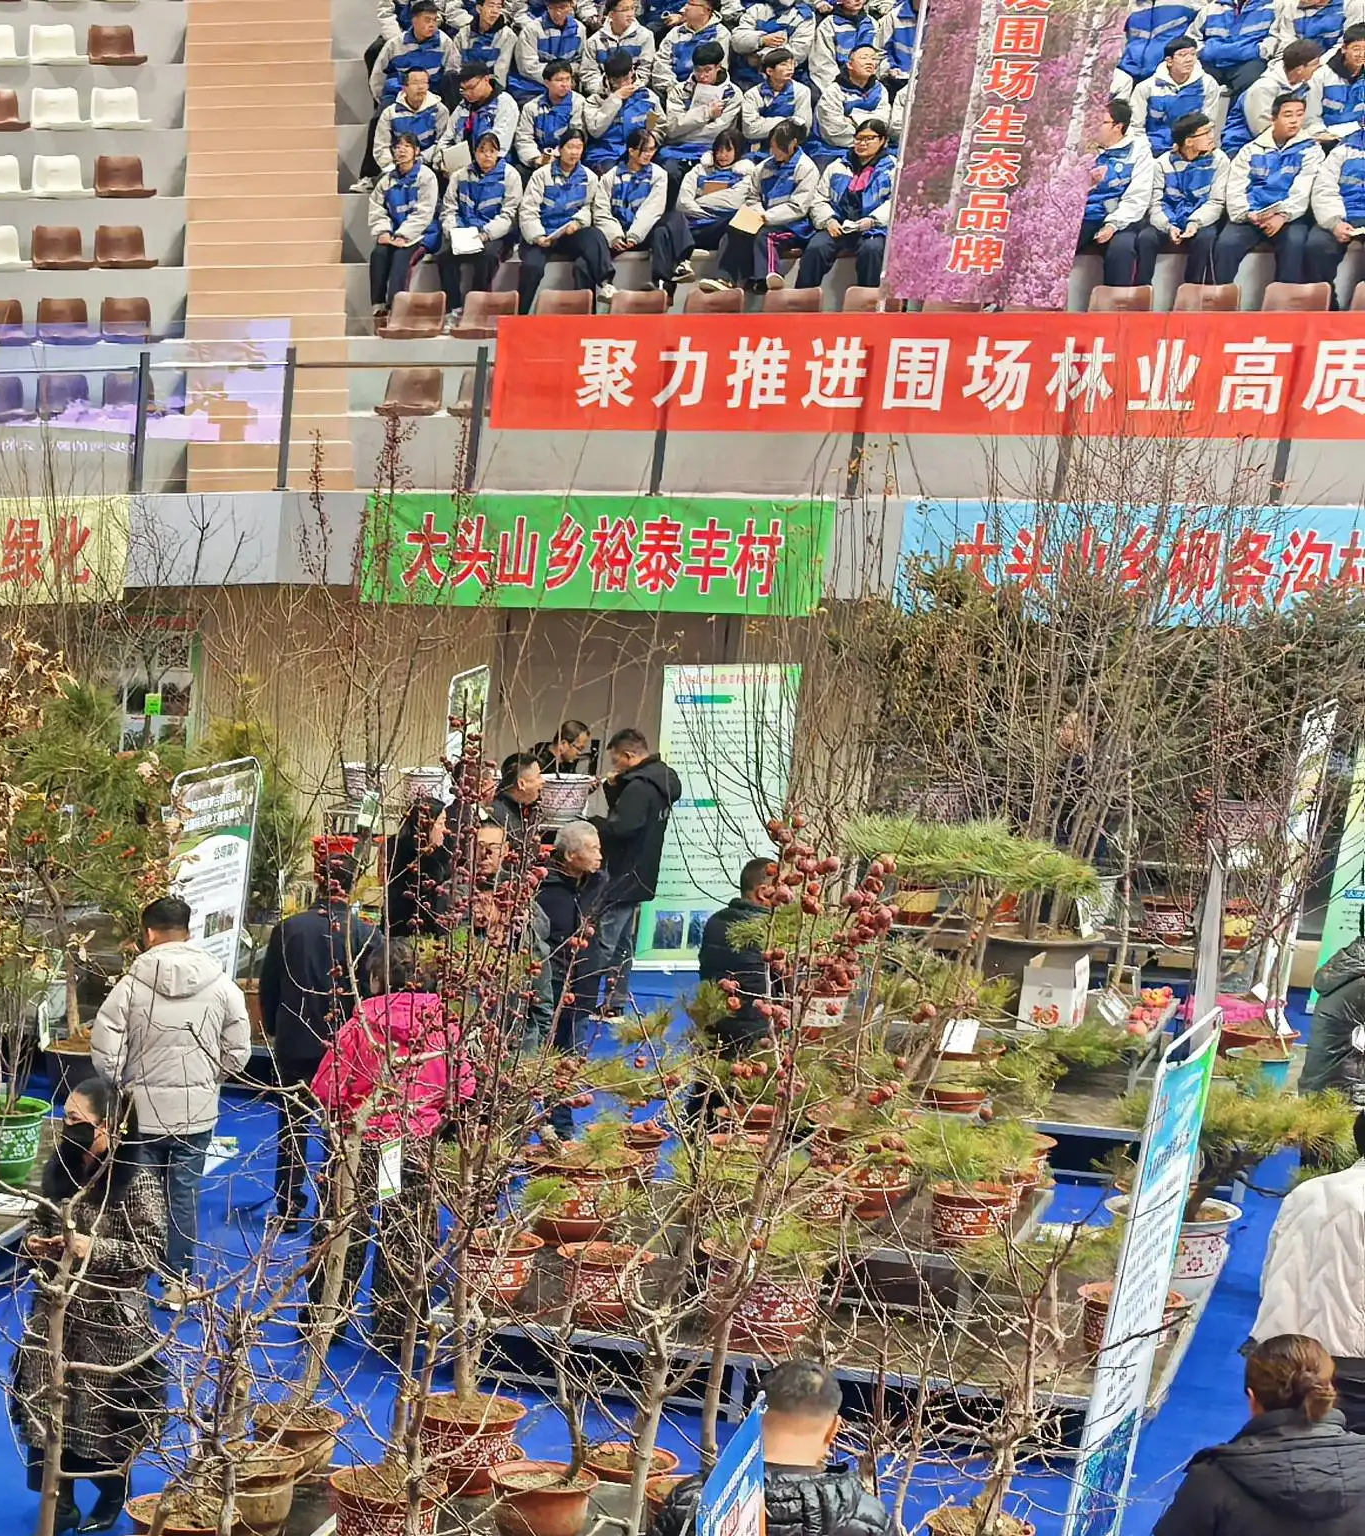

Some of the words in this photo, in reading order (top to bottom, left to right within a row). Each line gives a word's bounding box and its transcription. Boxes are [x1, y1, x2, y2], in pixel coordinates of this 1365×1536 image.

[946, 0, 1053, 275] 围场生态品牌
[400, 512, 788, 598] 大头山乡裕泰丰村
